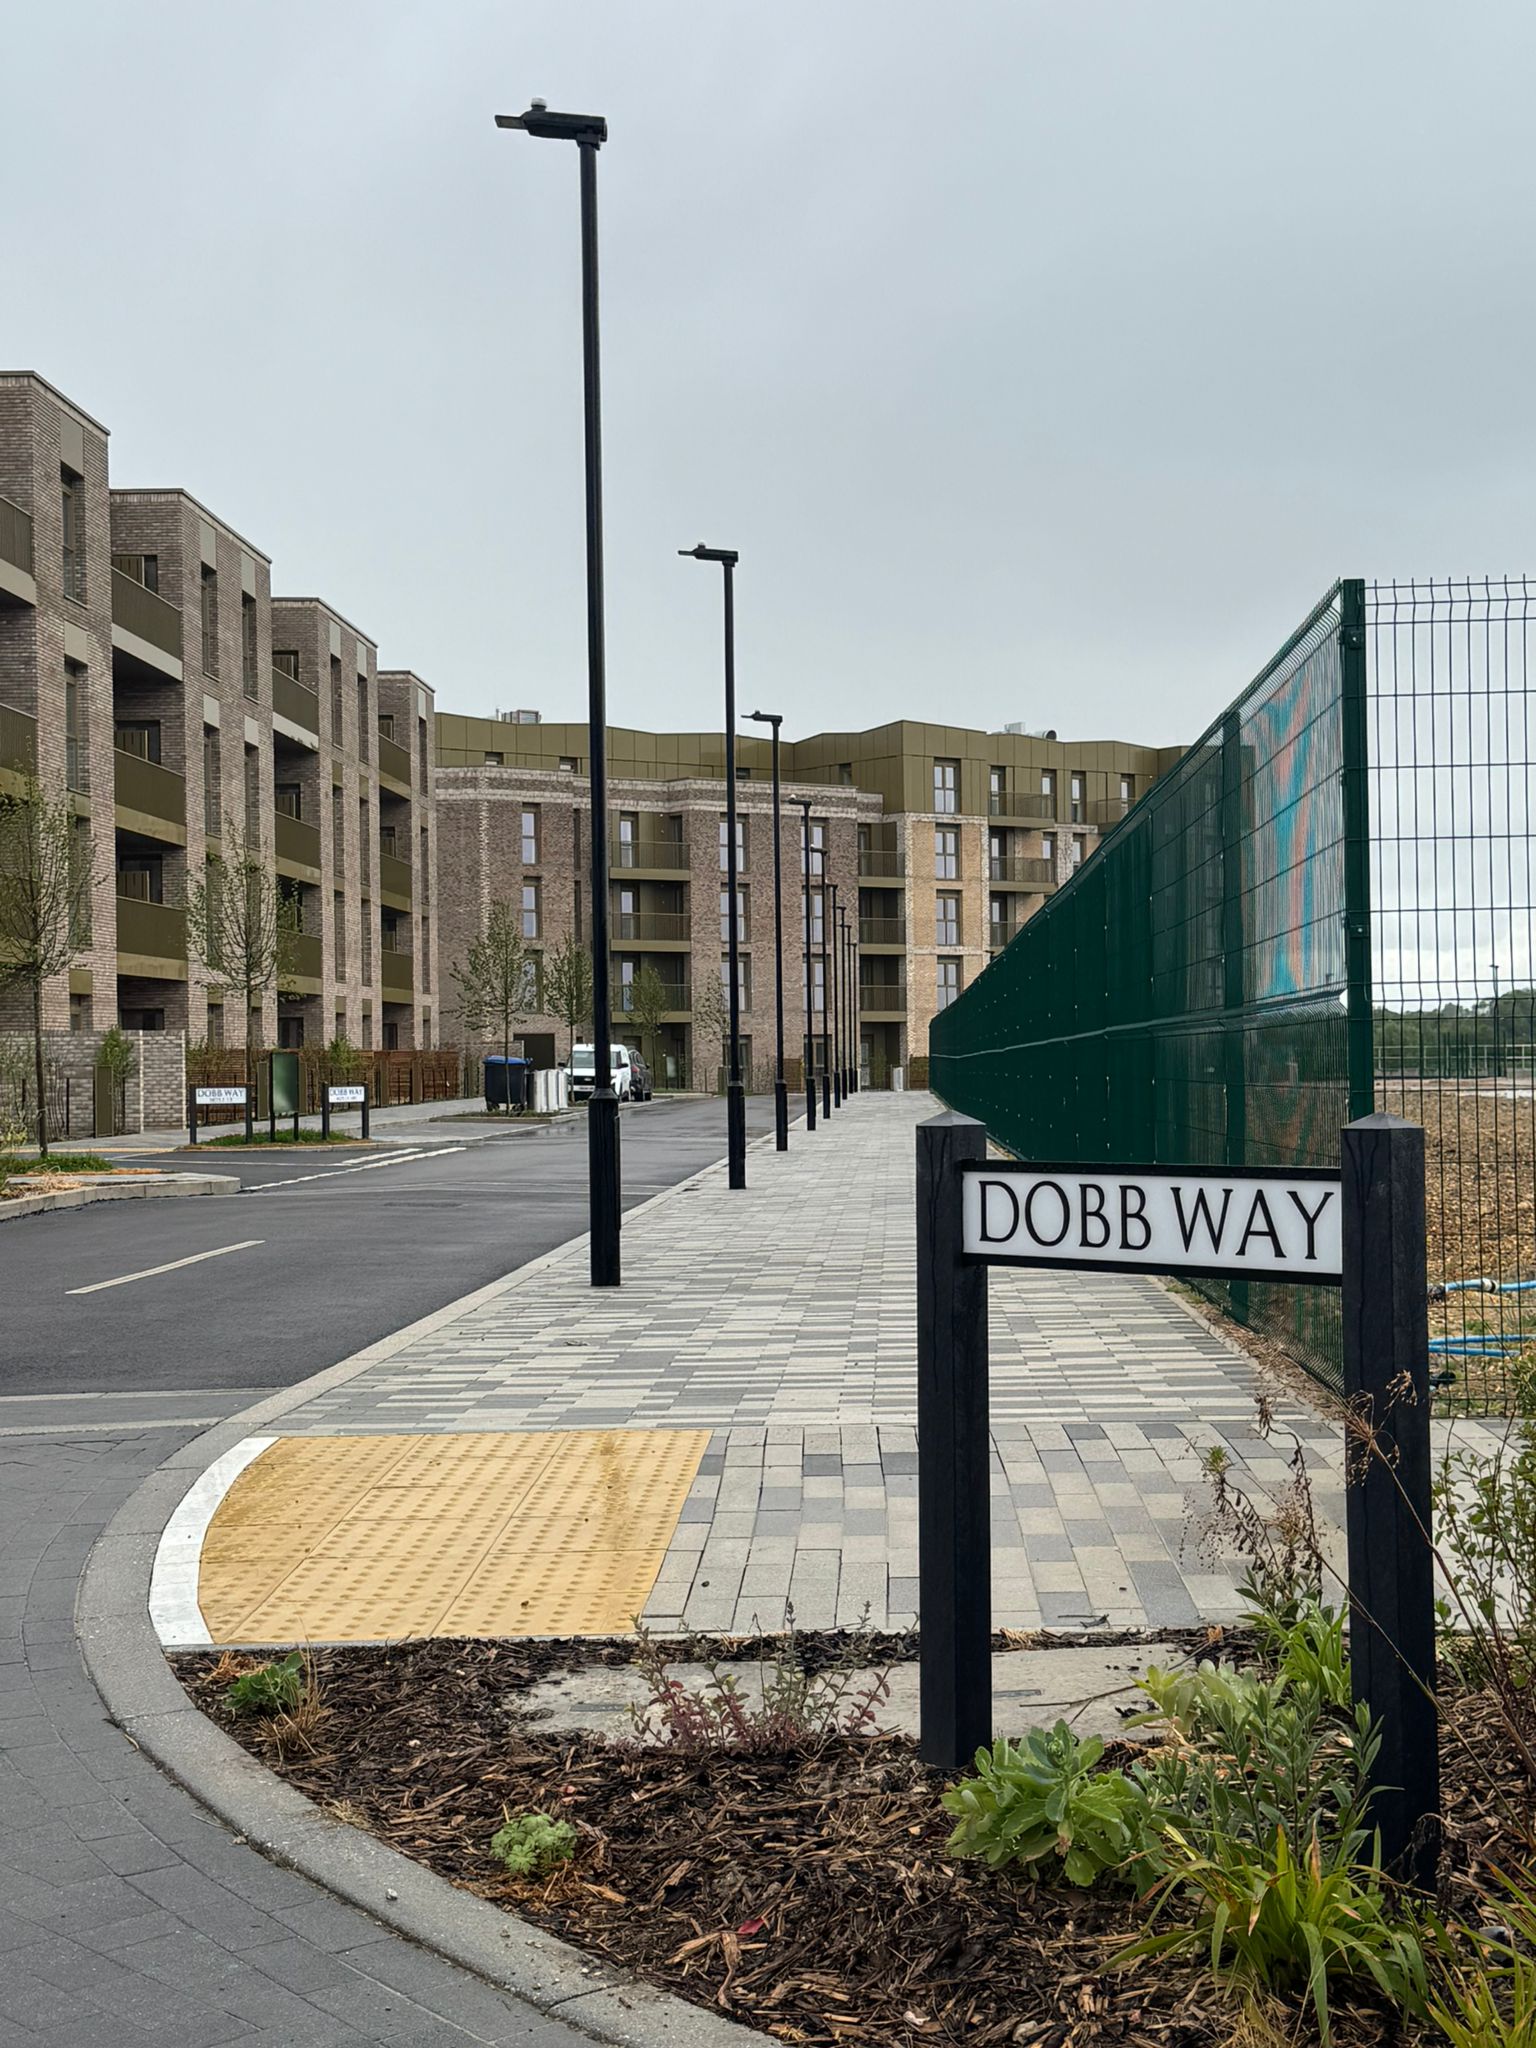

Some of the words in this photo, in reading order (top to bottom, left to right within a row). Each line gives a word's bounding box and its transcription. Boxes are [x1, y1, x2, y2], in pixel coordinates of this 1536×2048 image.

[198, 1089, 223, 1097] DOBB
[224, 1089, 244, 1097] WAY
[979, 1181, 1152, 1251] DOBB
[1170, 1187, 1335, 1259] WAY
